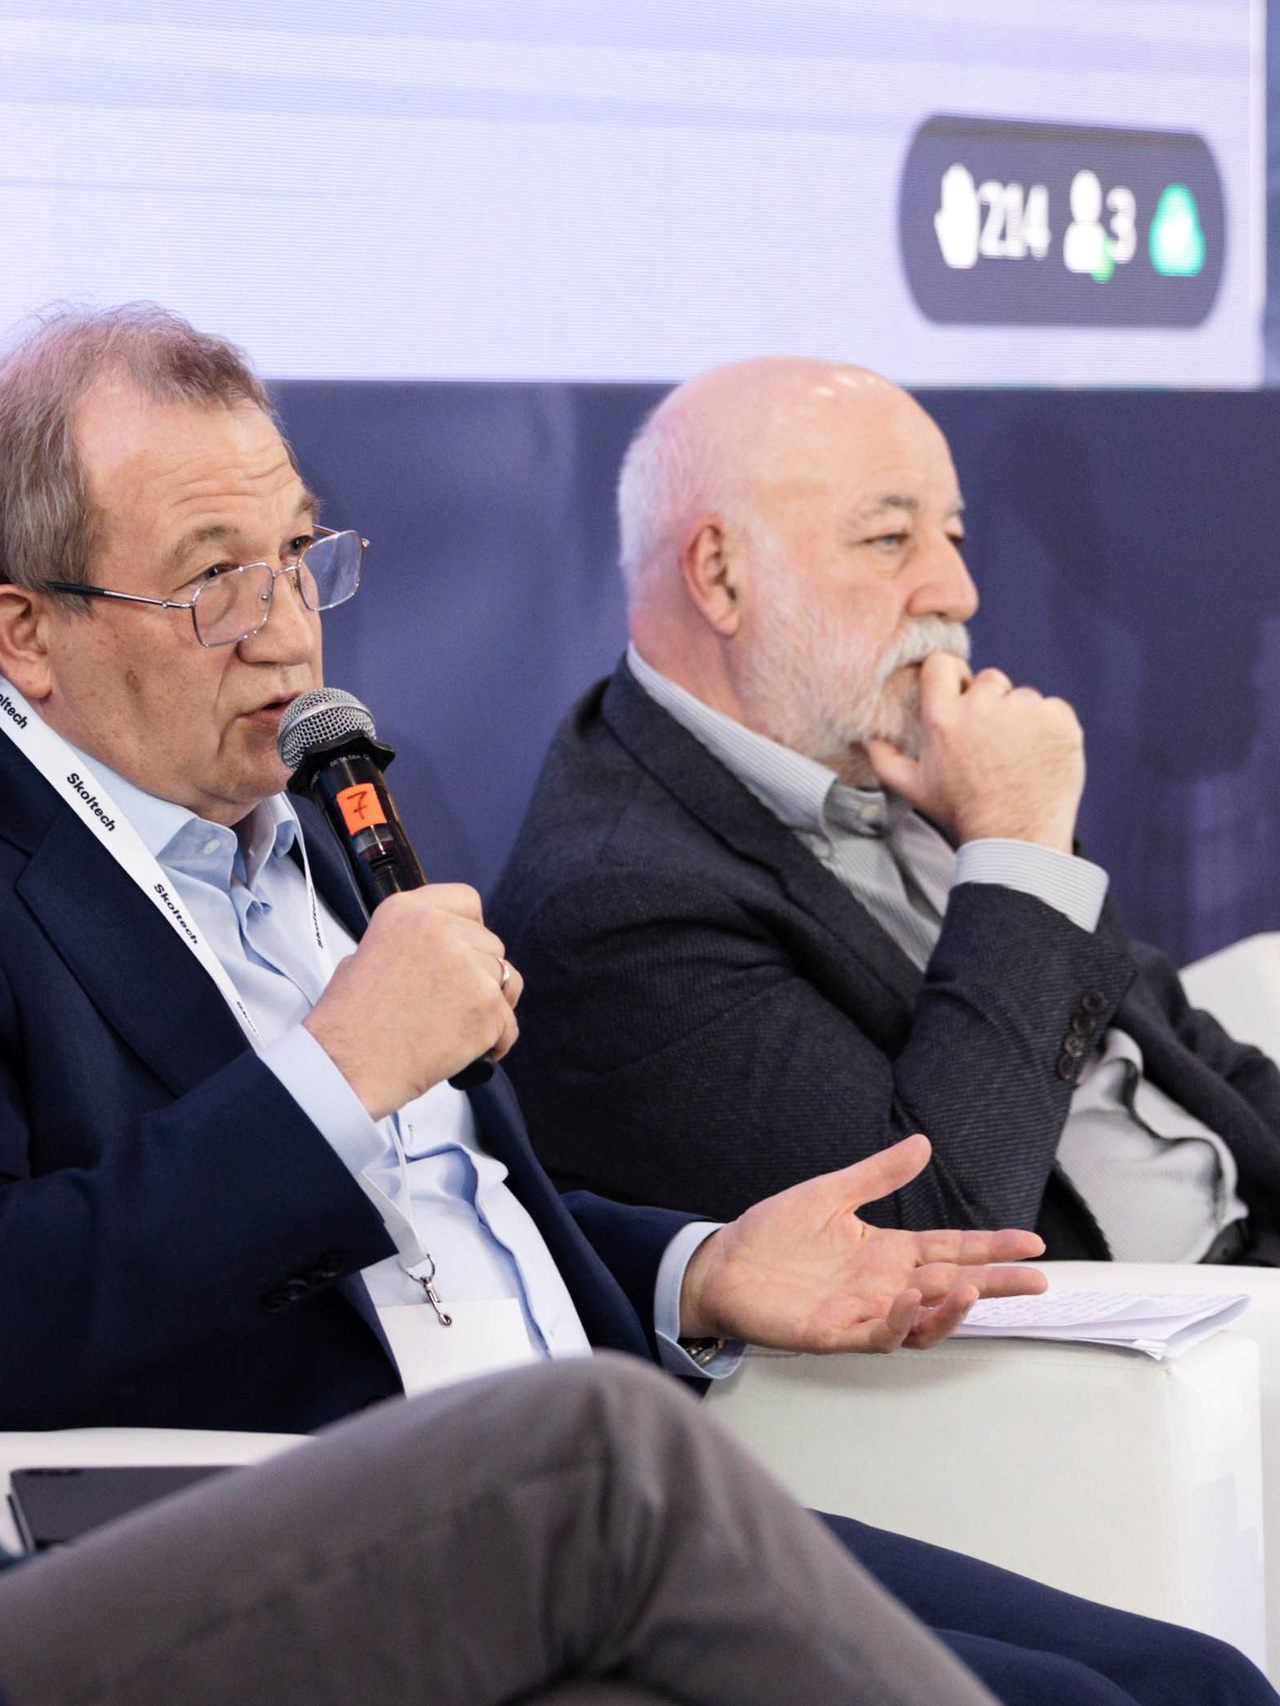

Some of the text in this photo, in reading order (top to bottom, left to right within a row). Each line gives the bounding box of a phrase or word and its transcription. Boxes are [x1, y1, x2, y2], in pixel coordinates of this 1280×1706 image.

[1107, 185, 1137, 264] 3
[66, 772, 116, 832] Skoltech
[346, 790, 368, 820] 7
[153, 883, 198, 945] Skoltech
